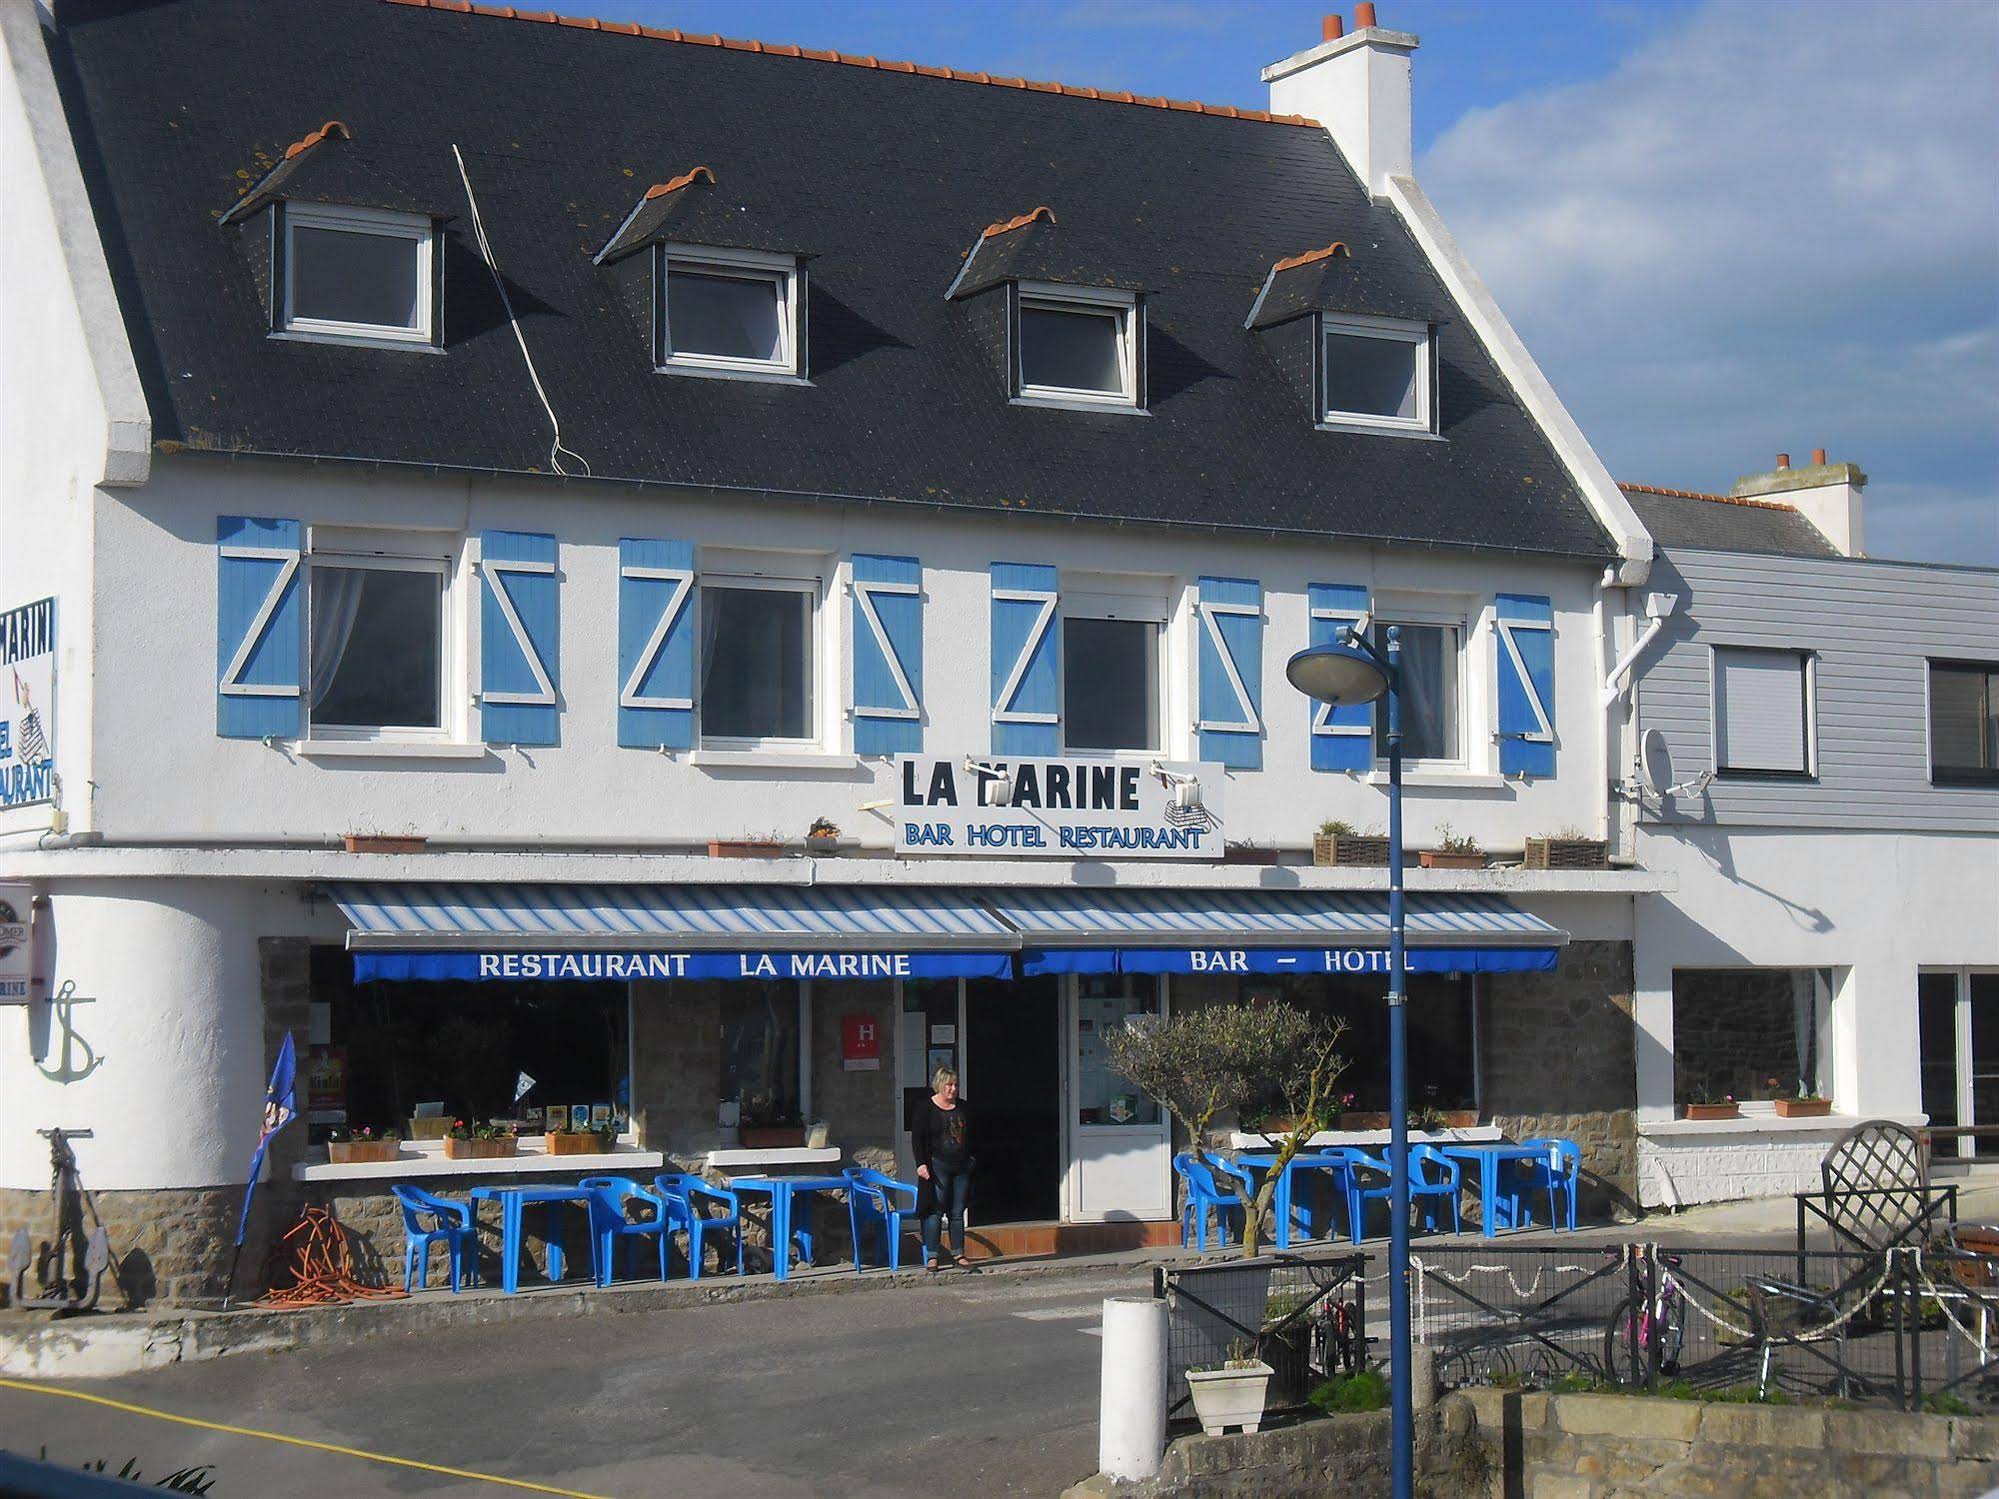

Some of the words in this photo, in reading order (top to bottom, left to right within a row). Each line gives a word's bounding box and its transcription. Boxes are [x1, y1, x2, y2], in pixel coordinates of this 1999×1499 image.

[903, 760, 958, 807] LA
[977, 762, 1141, 811] MARINE
[905, 822, 954, 846] BAR
[967, 824, 1047, 848] HOTEL
[1059, 826, 1205, 850] RESTAURANT
[479, 953, 691, 978] RESTAURANT
[740, 953, 777, 977] LA
[791, 953, 911, 977] MARINE
[1190, 950, 1249, 971] BAR
[858, 1023, 875, 1041] H
